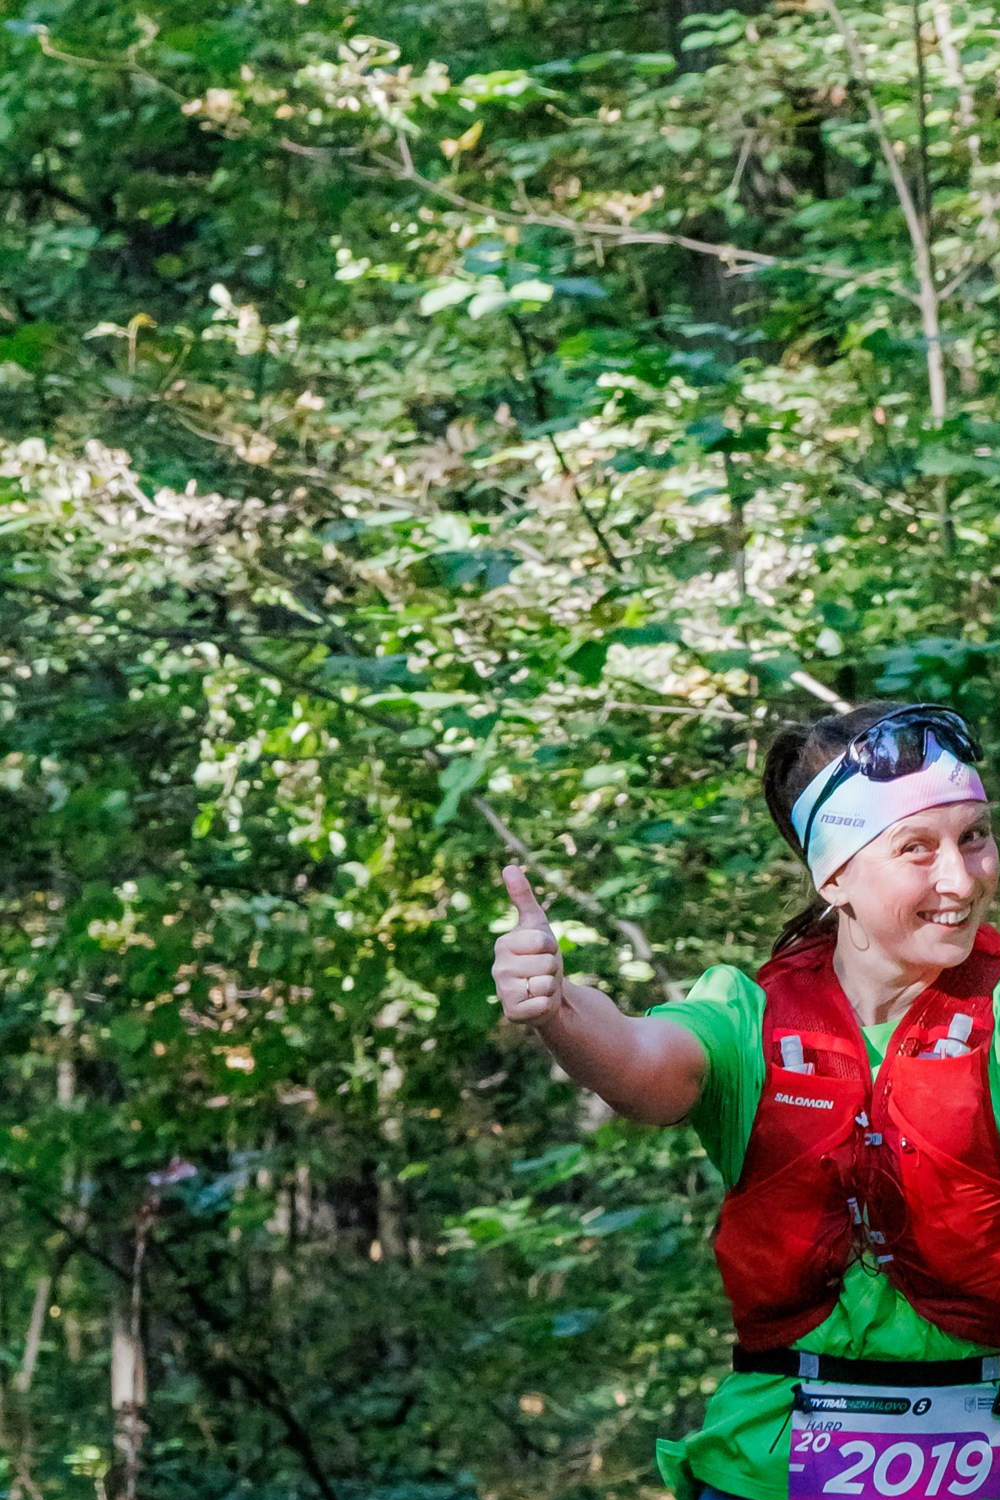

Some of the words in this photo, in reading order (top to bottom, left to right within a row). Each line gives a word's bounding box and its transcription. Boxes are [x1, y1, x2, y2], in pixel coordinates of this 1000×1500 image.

[774, 1092, 834, 1109] SALOMON
[916, 1400, 928, 1412] 5
[805, 1419, 843, 1431] HARD
[794, 1432, 831, 1453] 20
[822, 1440, 993, 1497] 2019
